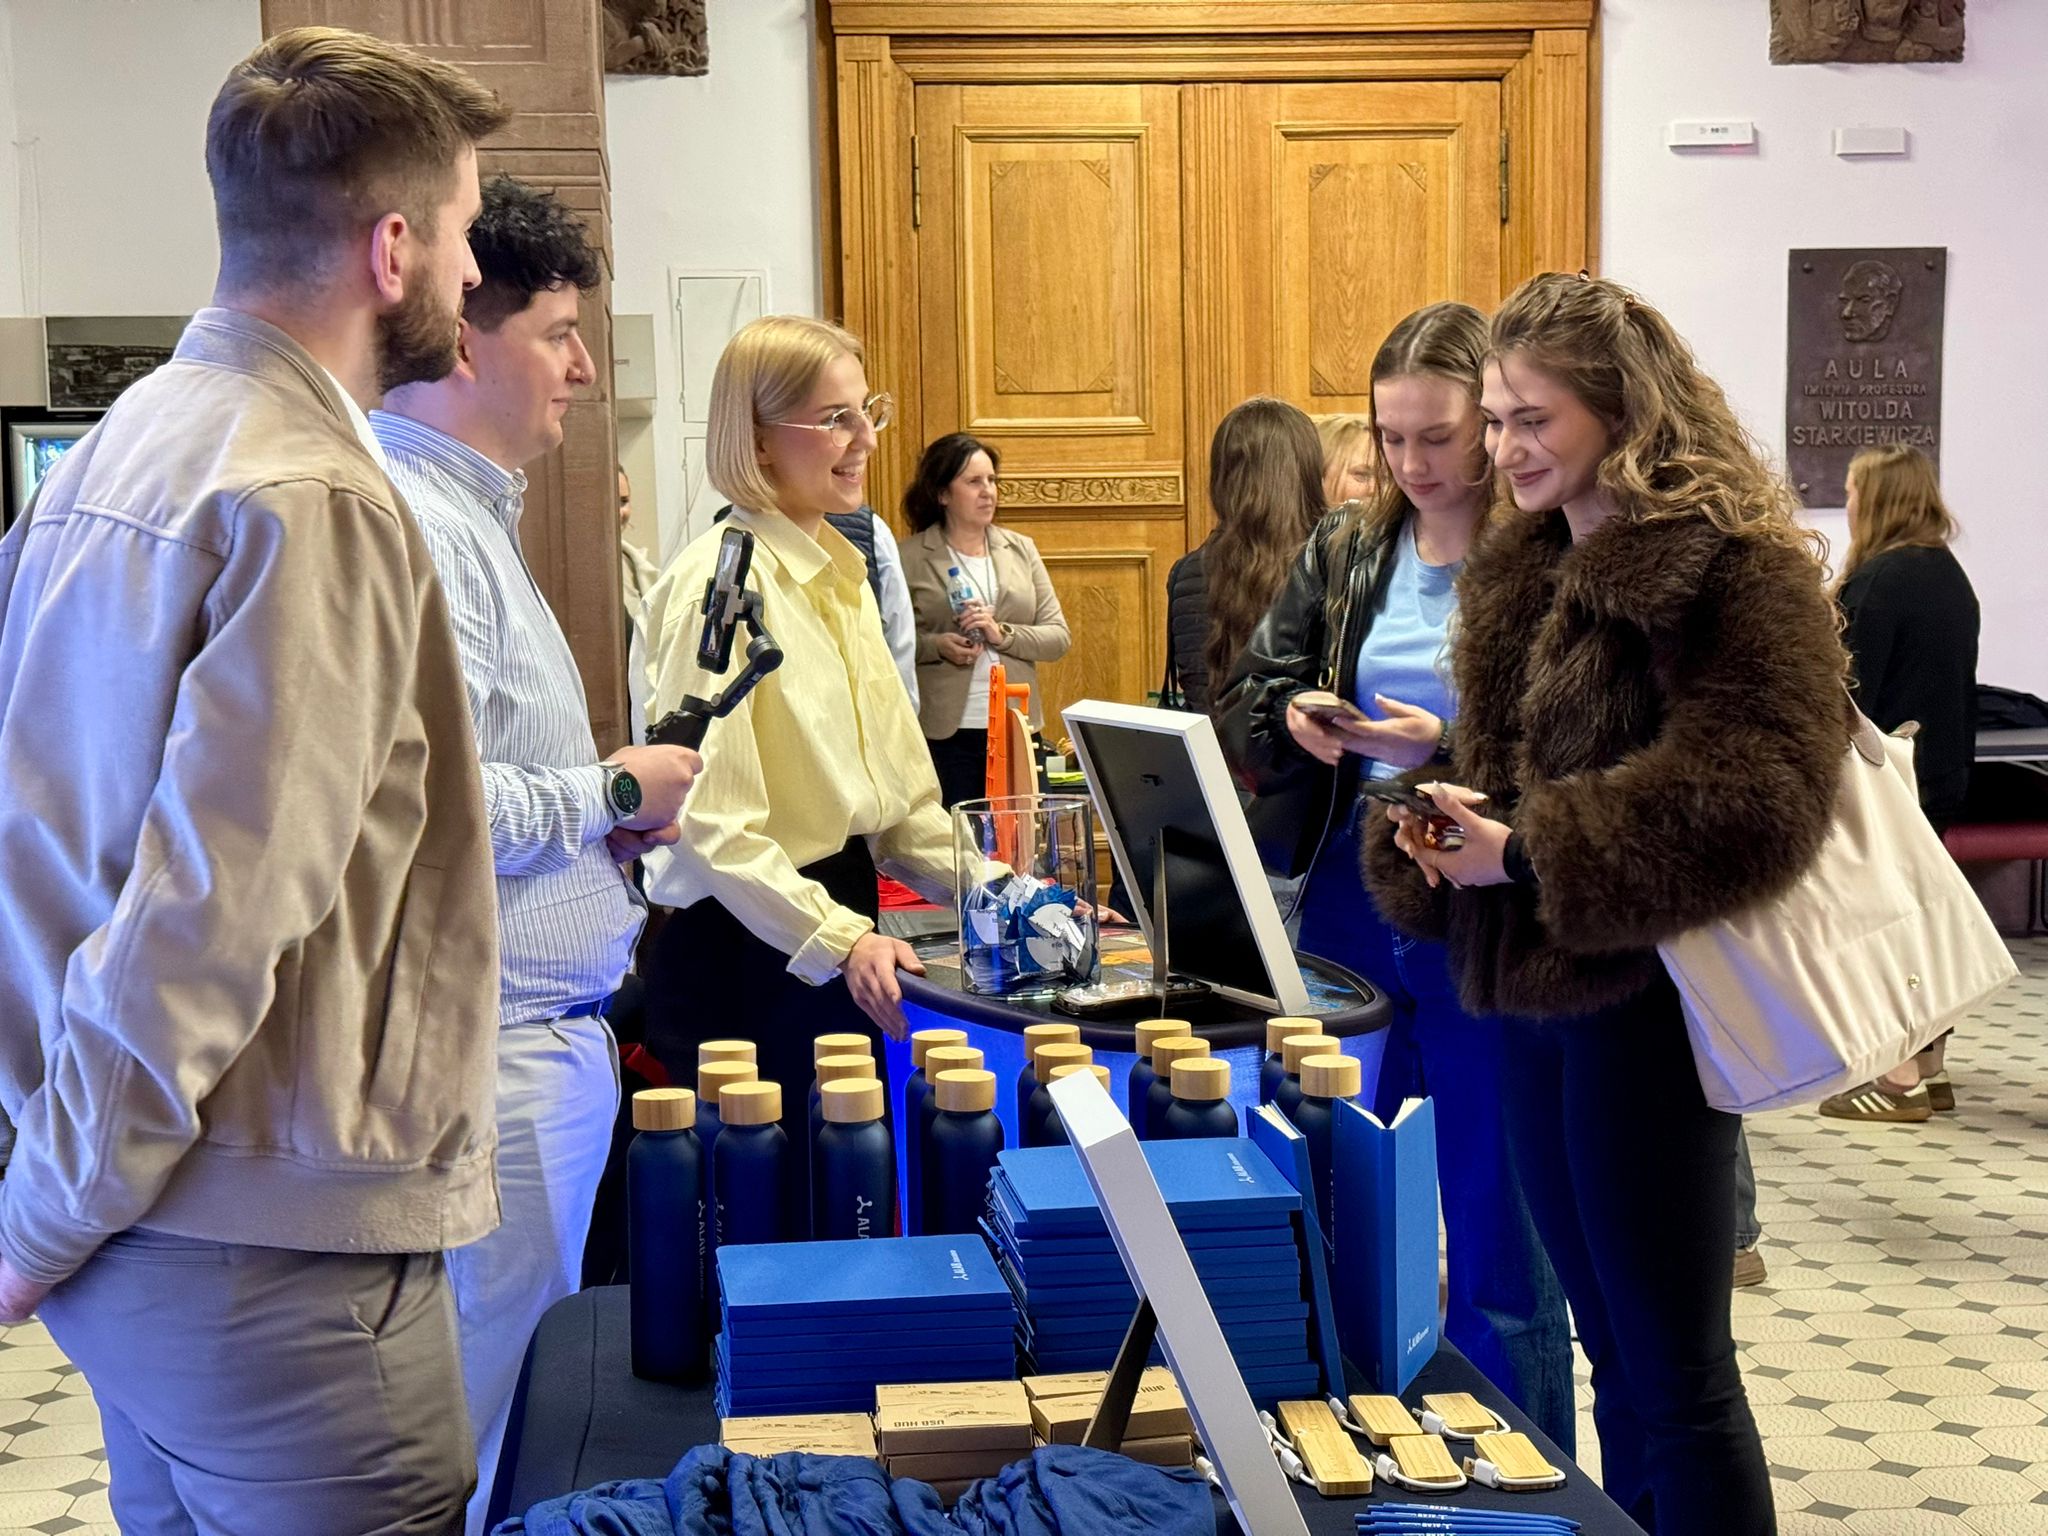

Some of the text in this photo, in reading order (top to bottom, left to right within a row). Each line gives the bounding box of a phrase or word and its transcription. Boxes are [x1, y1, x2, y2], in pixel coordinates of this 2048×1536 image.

[1824, 359, 1908, 379] AULA
[1859, 383, 1927, 395] PROFESORA
[1819, 400, 1914, 420] WITOLDA
[1792, 425, 1936, 446] STARKIEWICZA
[857, 1217, 870, 1240] ALA
